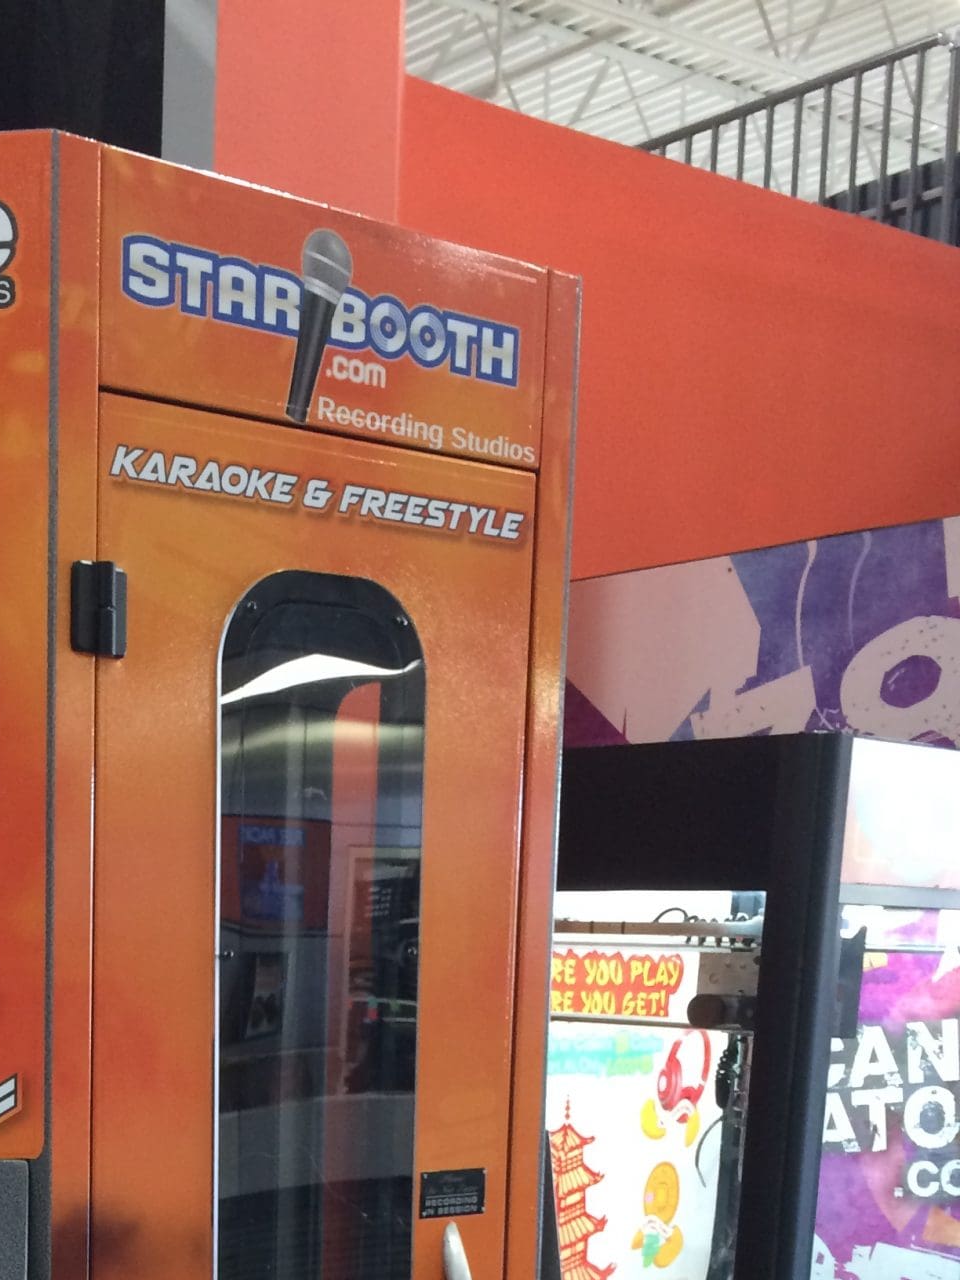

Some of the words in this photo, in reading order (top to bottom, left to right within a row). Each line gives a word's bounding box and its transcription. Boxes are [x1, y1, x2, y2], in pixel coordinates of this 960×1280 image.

[127, 242, 303, 336] STAR
[330, 293, 514, 380] BOOTH
[324, 355, 387, 389] .com
[318, 397, 443, 449] Recording
[452, 427, 536, 463] Studios
[111, 446, 299, 502] KARAOKE
[303, 479, 332, 510] &
[339, 486, 525, 540] FREESTYLE
[583, 959, 624, 986] YOU
[630, 959, 681, 987] PLAY
[581, 990, 616, 1014] YOU
[622, 990, 666, 1017] GET!
